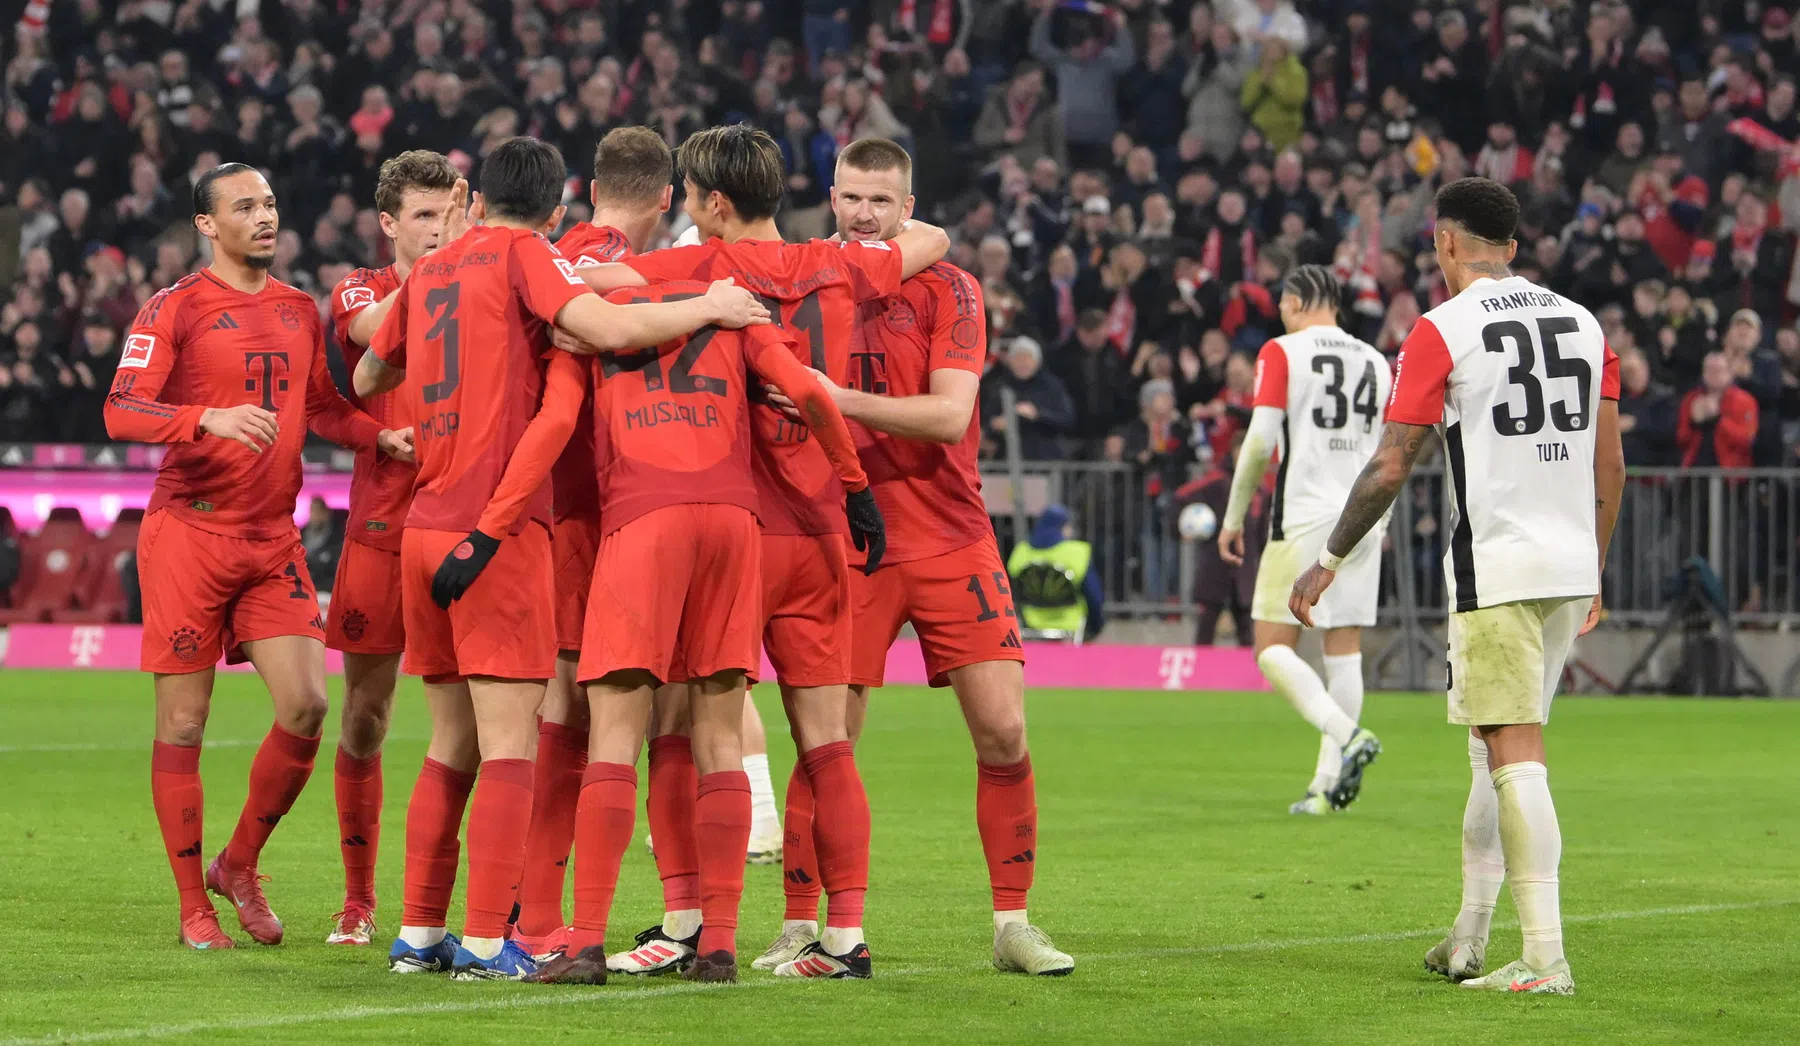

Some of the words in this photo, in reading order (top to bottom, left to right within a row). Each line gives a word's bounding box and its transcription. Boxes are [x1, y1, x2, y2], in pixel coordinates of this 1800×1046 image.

[1480, 292, 1563, 313] FRANKFURT
[424, 281, 461, 405] 3
[1311, 354, 1379, 435] 34
[1481, 316, 1592, 437] 35
[625, 401, 719, 431] MUSIALA
[1536, 442, 1570, 463] TUTA
